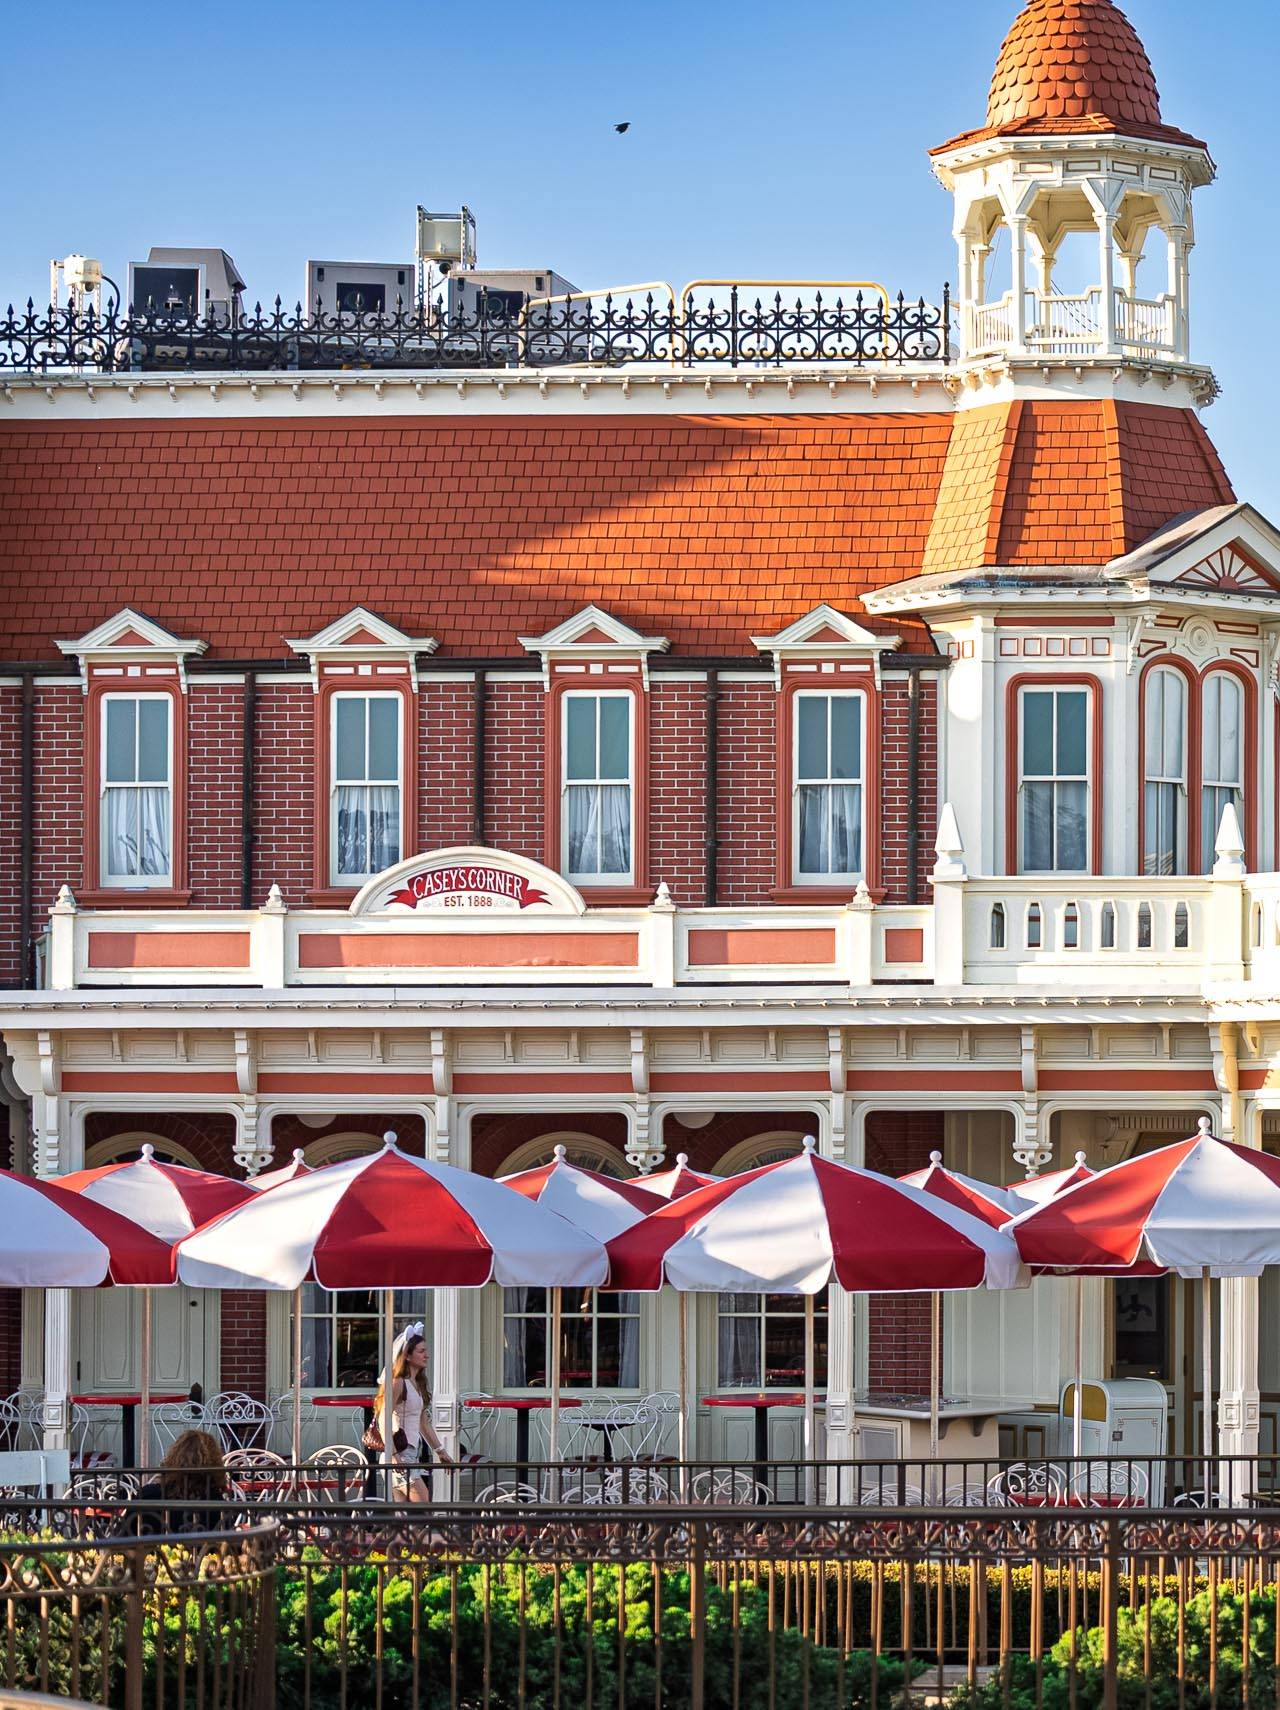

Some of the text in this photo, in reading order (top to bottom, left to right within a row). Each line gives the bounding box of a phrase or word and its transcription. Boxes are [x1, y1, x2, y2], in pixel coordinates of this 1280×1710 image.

[413, 868, 523, 900] CASEY'S CORNER
[444, 896, 493, 907] EST. 1888
